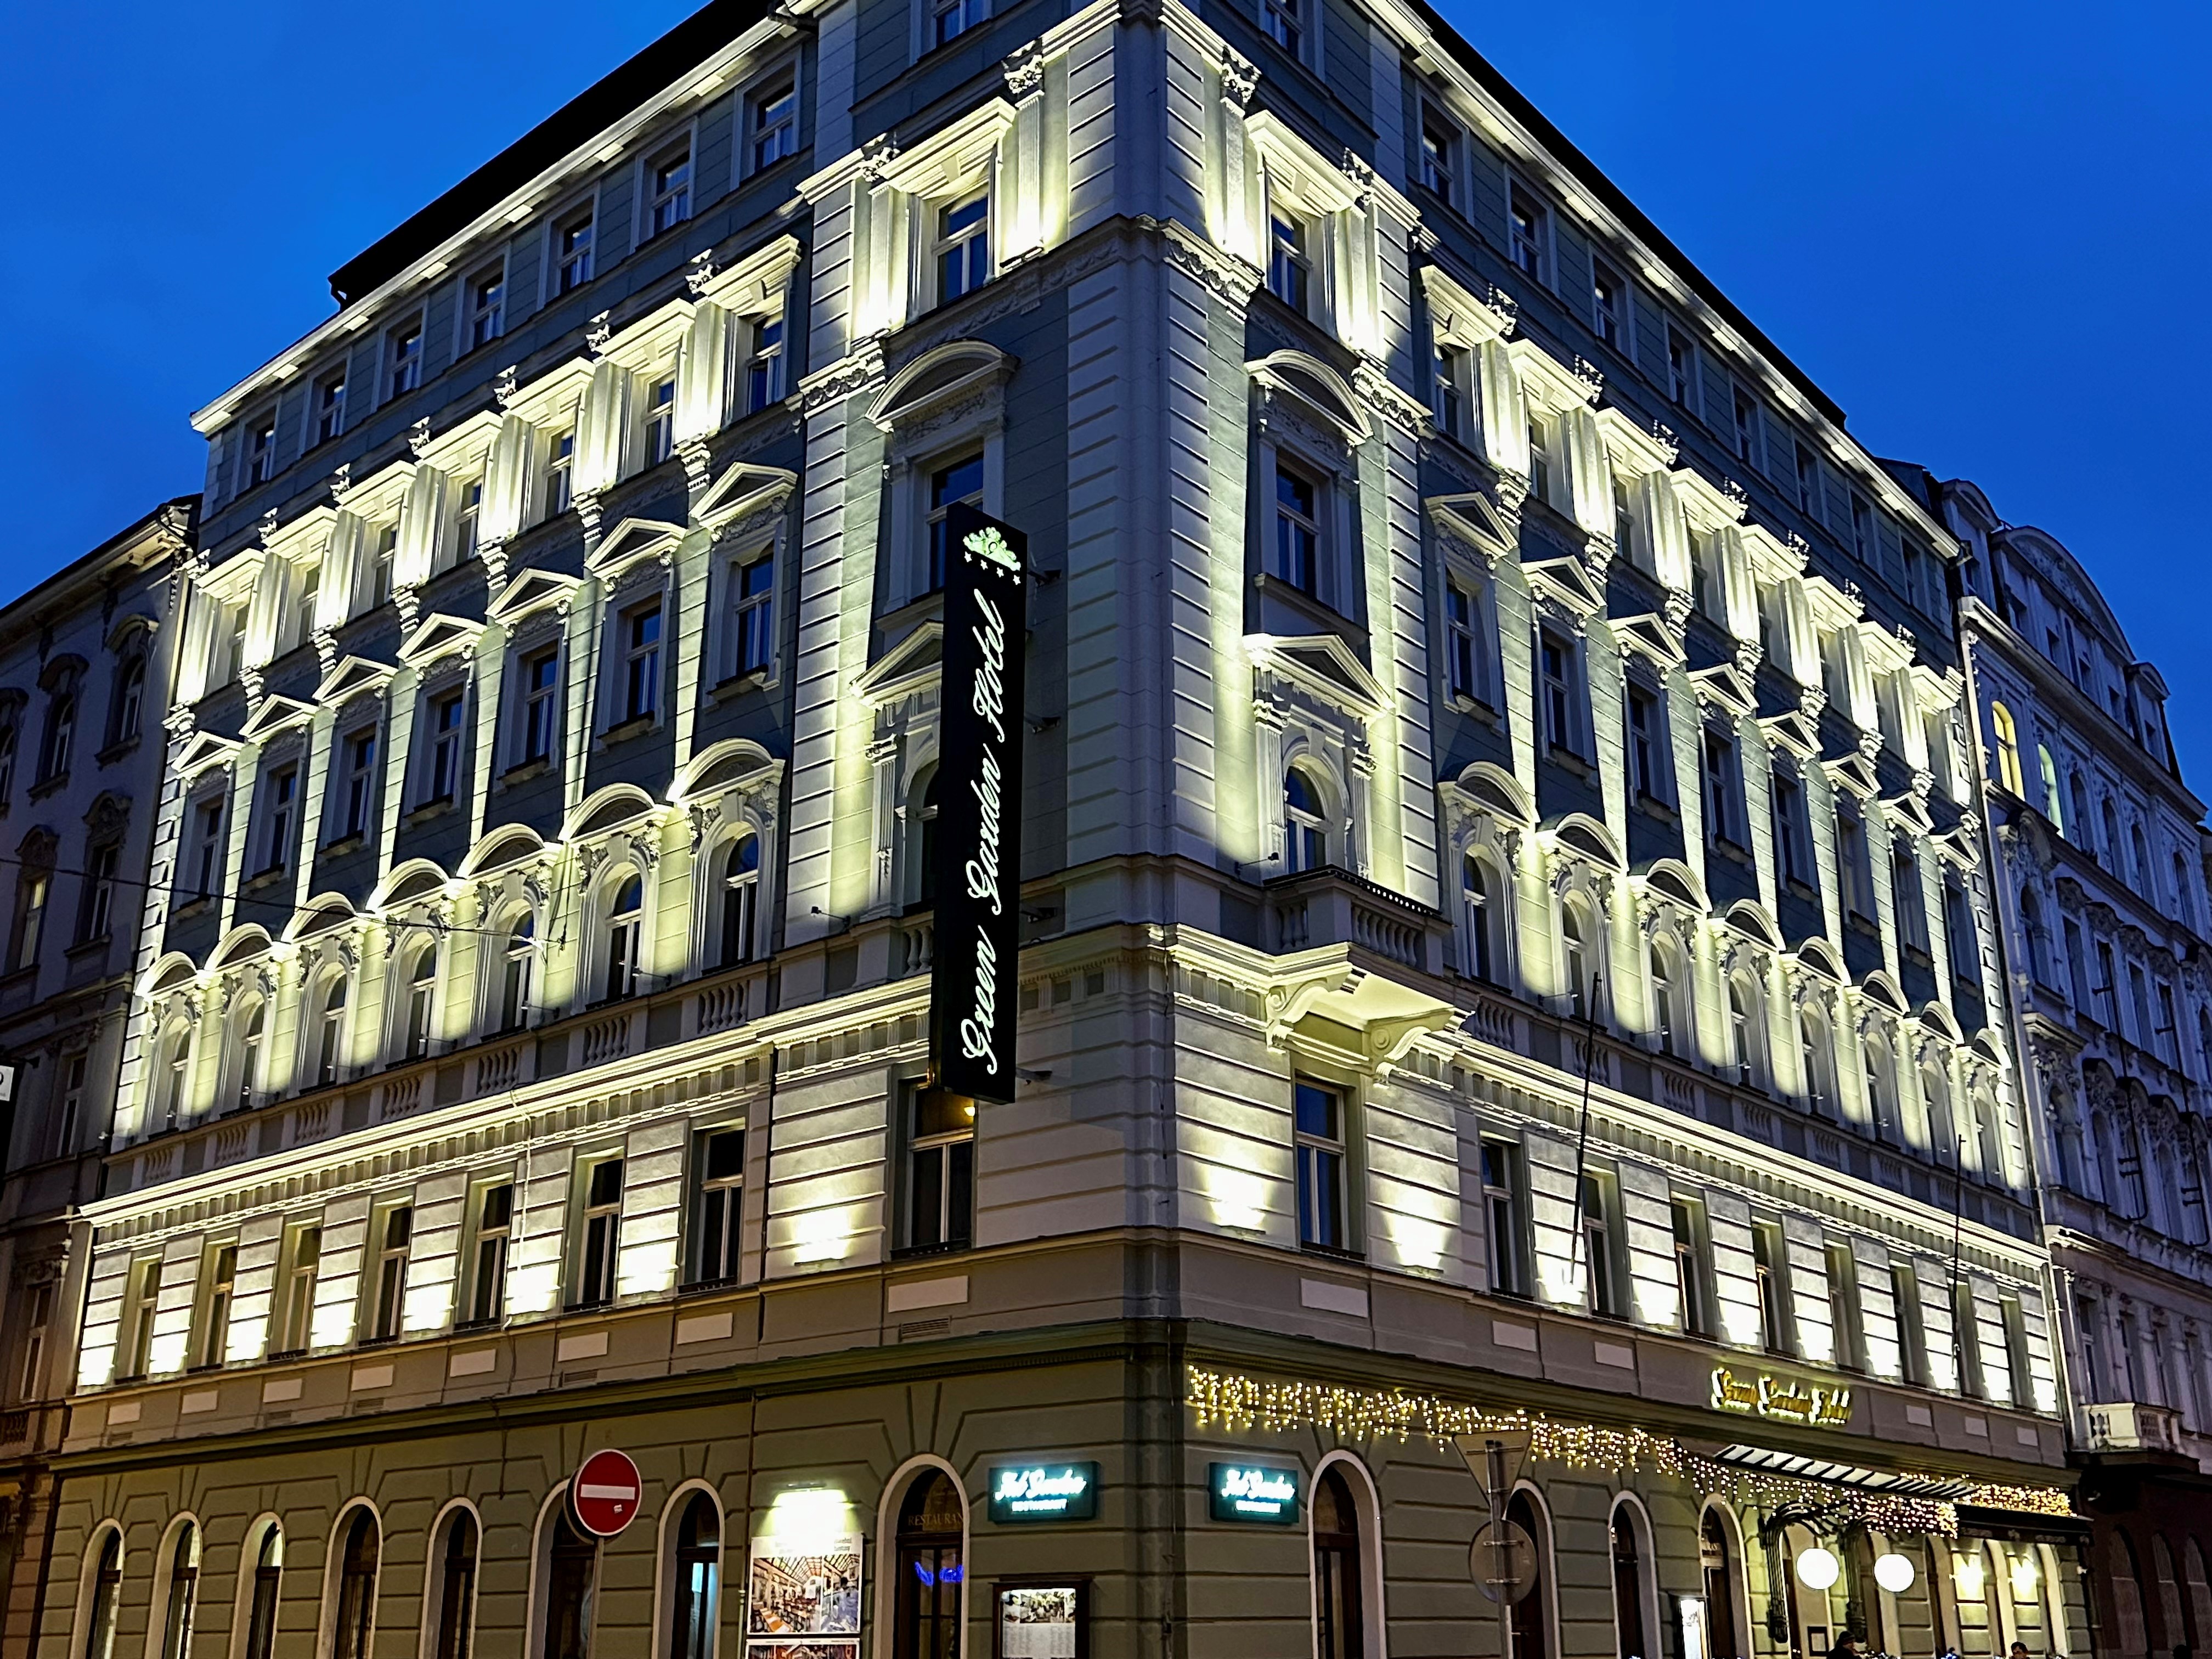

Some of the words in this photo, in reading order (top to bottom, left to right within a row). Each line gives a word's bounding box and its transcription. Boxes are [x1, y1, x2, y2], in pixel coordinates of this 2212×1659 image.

[972, 588, 1005, 742] Hotel
[966, 743, 1002, 916] Garden
[961, 925, 997, 1075] Green
[908, 1512, 963, 1526] RESTAURAN
